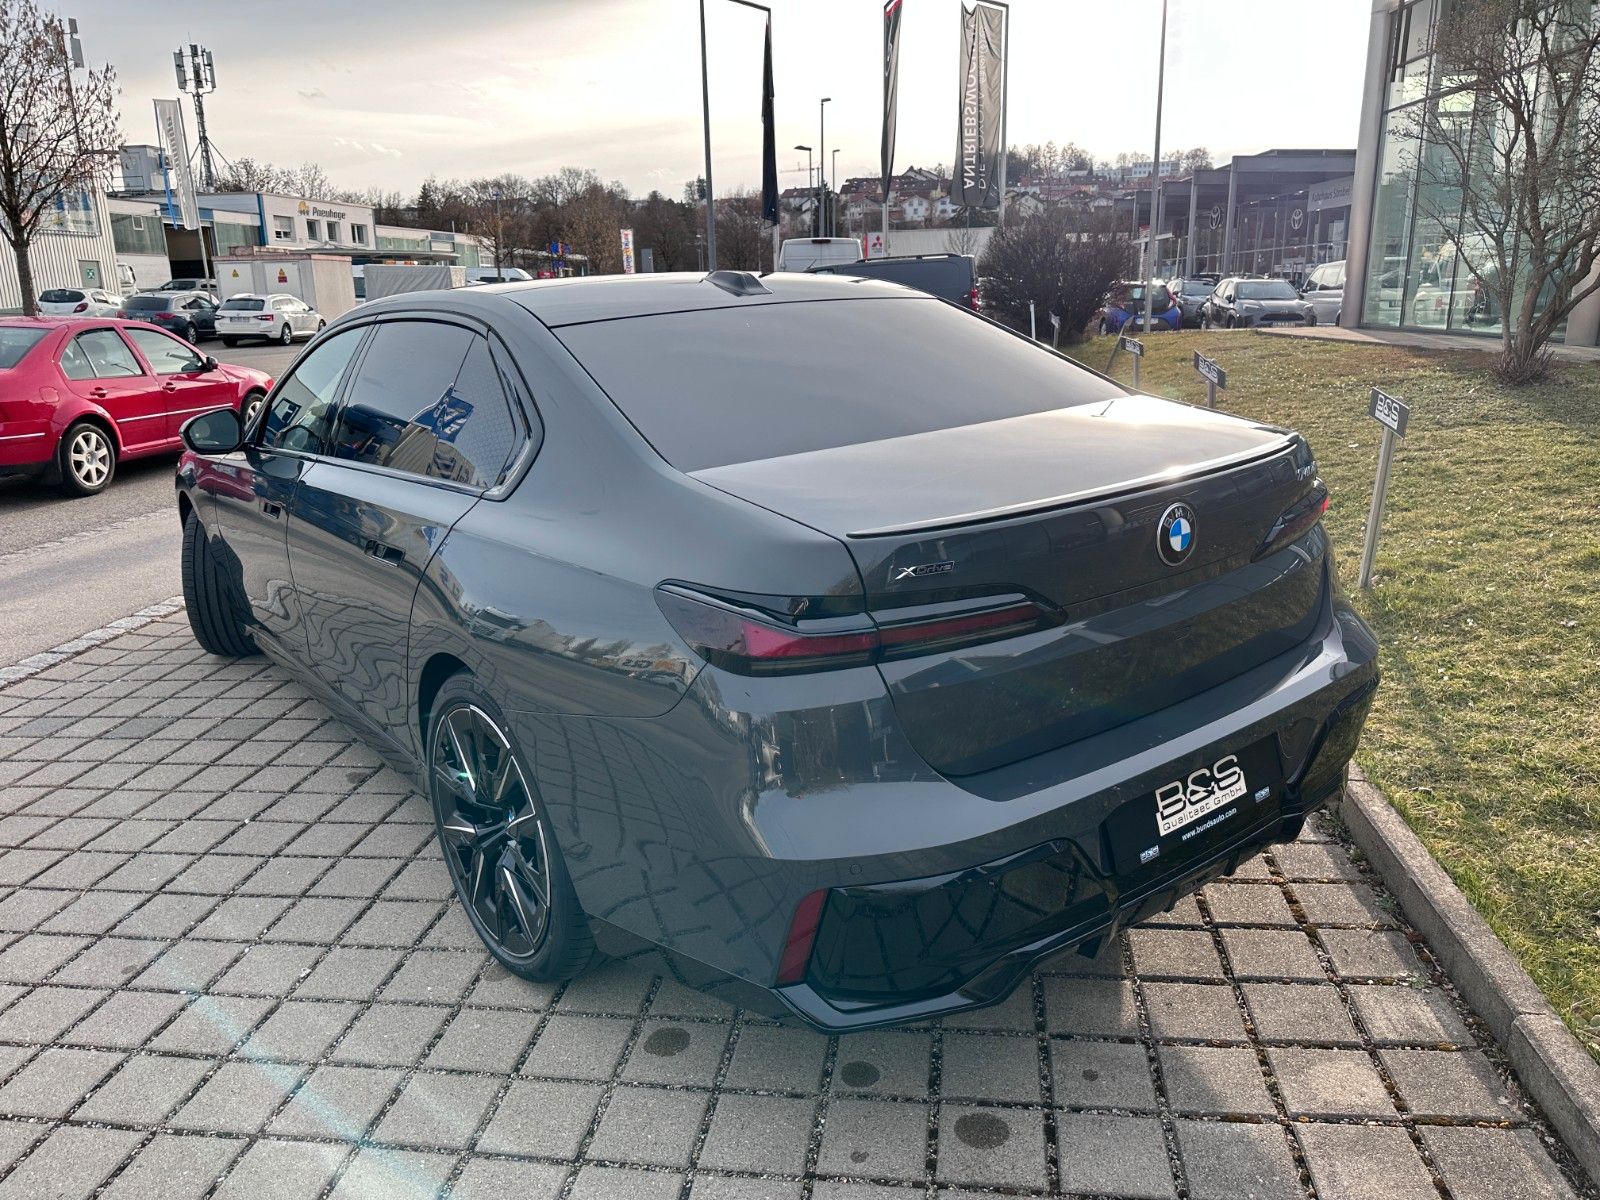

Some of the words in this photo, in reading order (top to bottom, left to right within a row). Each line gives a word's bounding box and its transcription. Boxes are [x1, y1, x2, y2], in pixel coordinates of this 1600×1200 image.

[312, 206, 346, 221] Pneuhage
[1375, 394, 1400, 423] B&S
[1163, 507, 1195, 530] BMW
[1155, 753, 1244, 822] B&S
[1162, 802, 1212, 832] Qualitaet
[1213, 786, 1244, 807] GmbH
[1181, 806, 1238, 841] www.bundsauto.com
